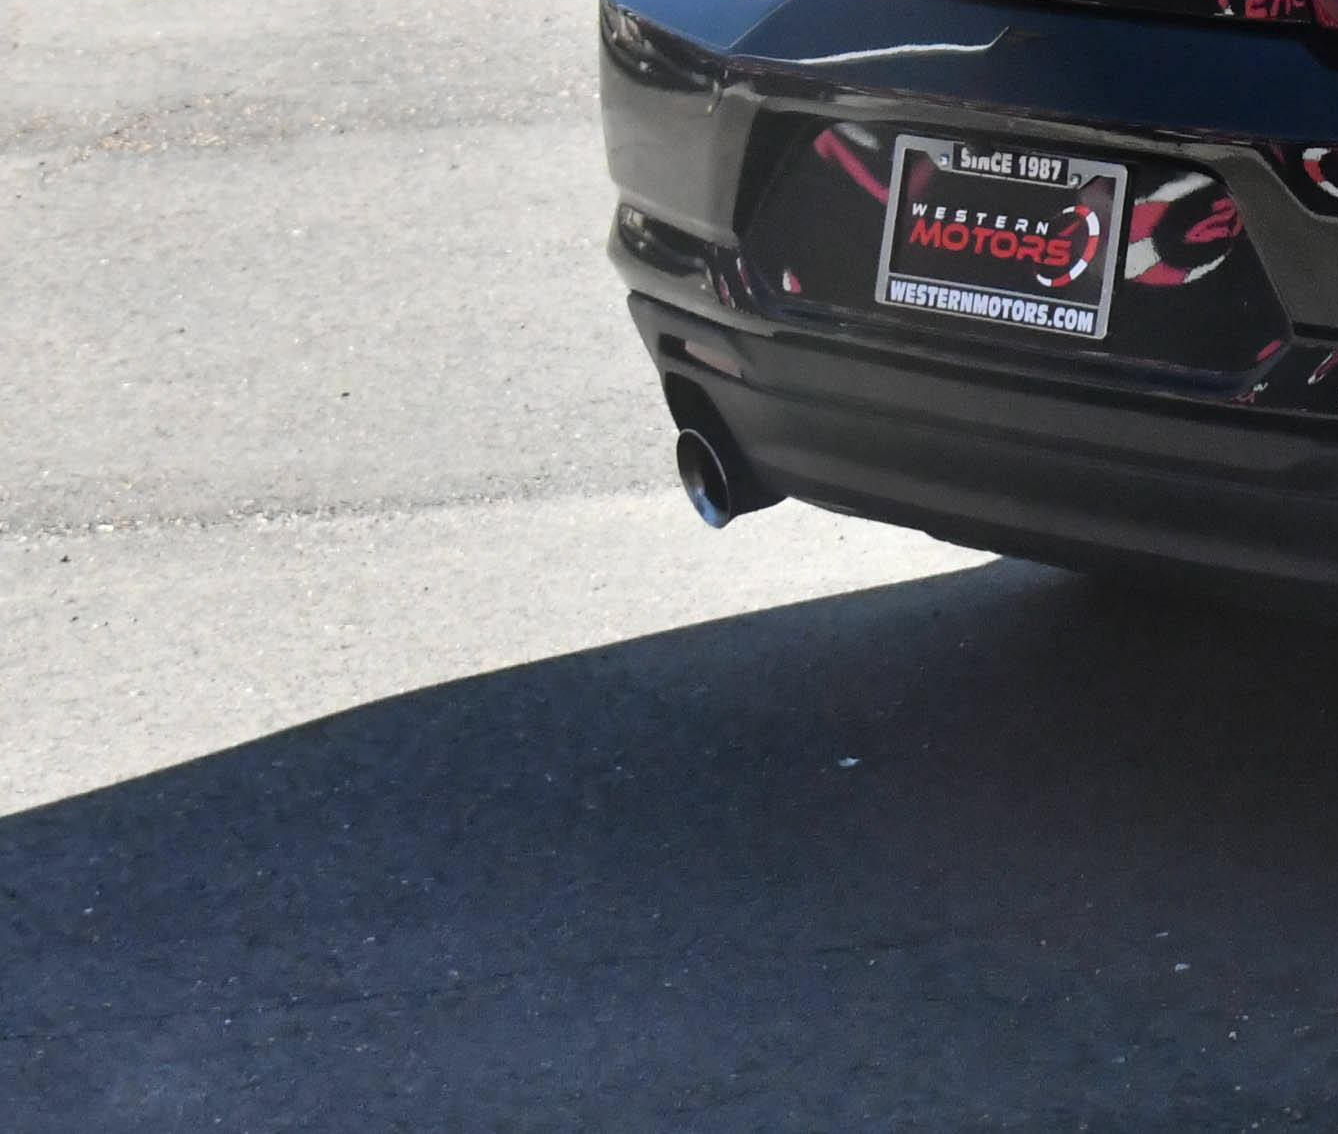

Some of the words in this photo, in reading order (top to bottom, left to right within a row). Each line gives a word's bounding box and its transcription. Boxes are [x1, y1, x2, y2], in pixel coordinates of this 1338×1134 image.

[960, 148, 1012, 174] SINCE
[1018, 155, 1062, 180] 1987
[911, 203, 1050, 235] WESTERN
[909, 218, 1073, 266] MOTORS
[890, 280, 1095, 333] WESTERNMOTORS.COM
